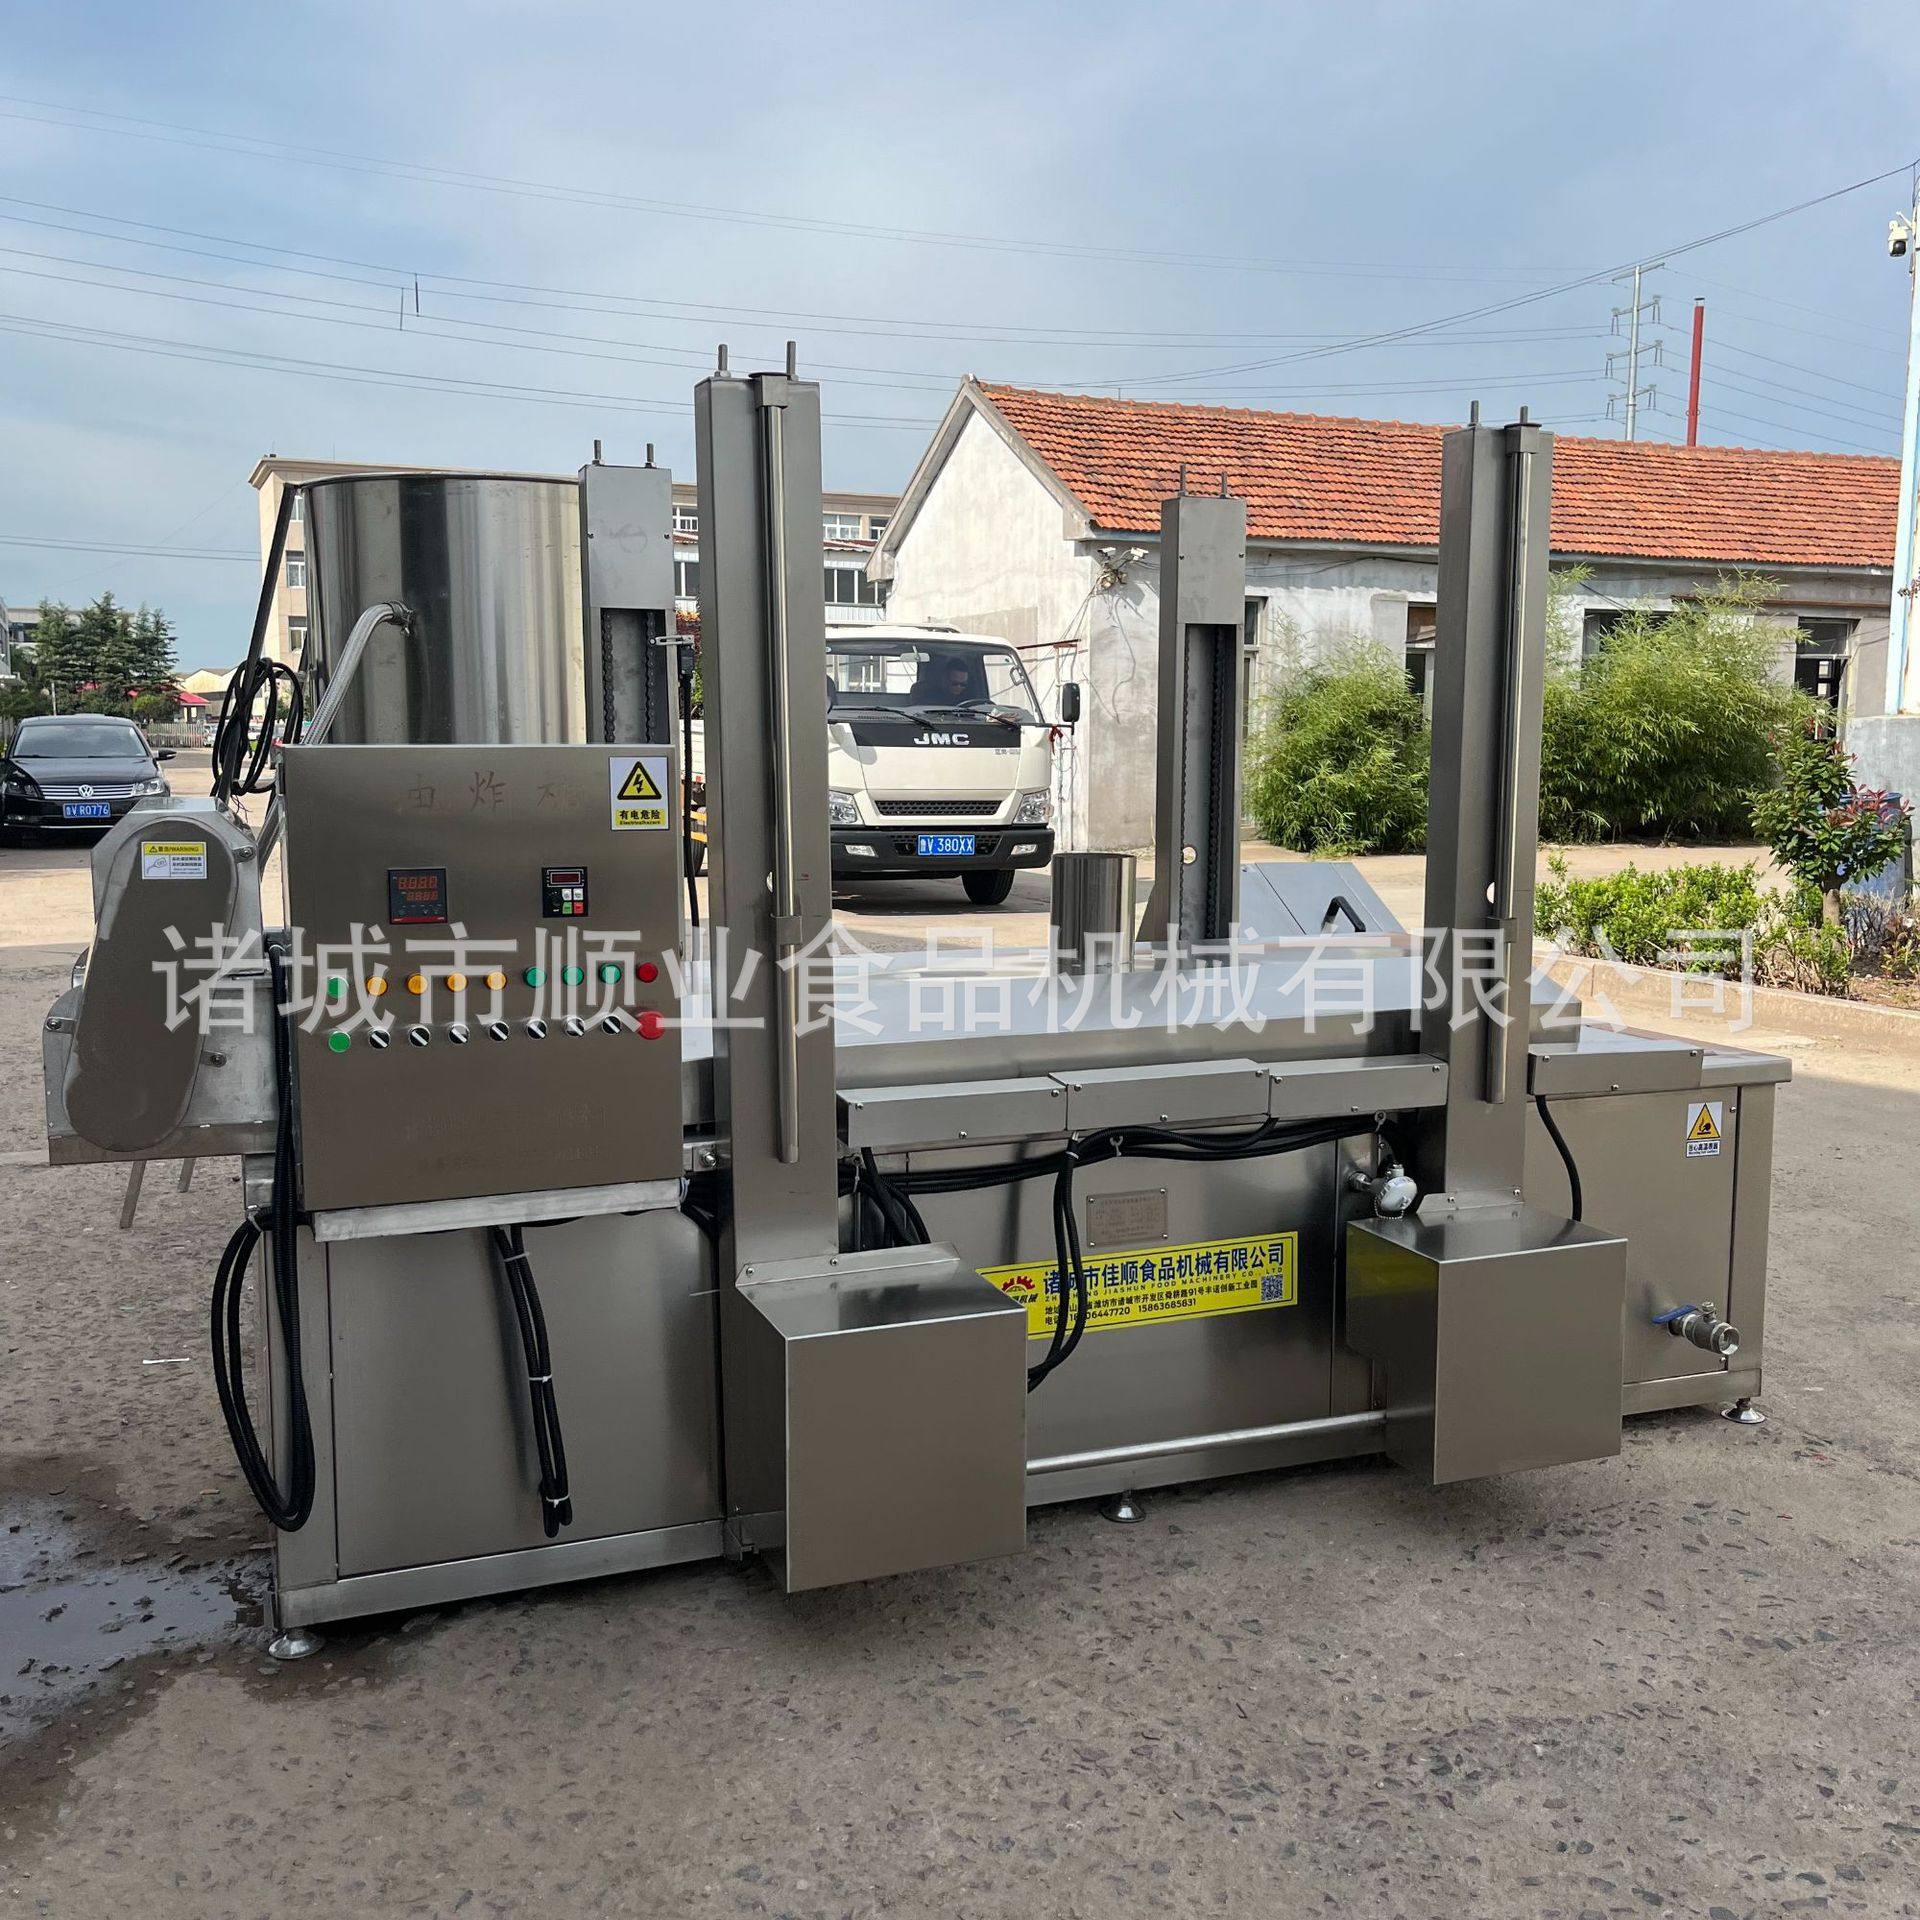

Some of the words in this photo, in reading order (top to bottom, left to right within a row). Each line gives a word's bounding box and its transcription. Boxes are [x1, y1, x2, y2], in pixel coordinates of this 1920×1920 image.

[913, 733, 970, 746] JMC
[619, 809, 660, 820] 有电危险
[1103, 1284, 1146, 1295] JIASHUN
[1150, 1280, 1177, 1289] FOOD
[1181, 1272, 1237, 1285] MACHINERY
[1138, 1298, 1196, 1313] 15863685831
